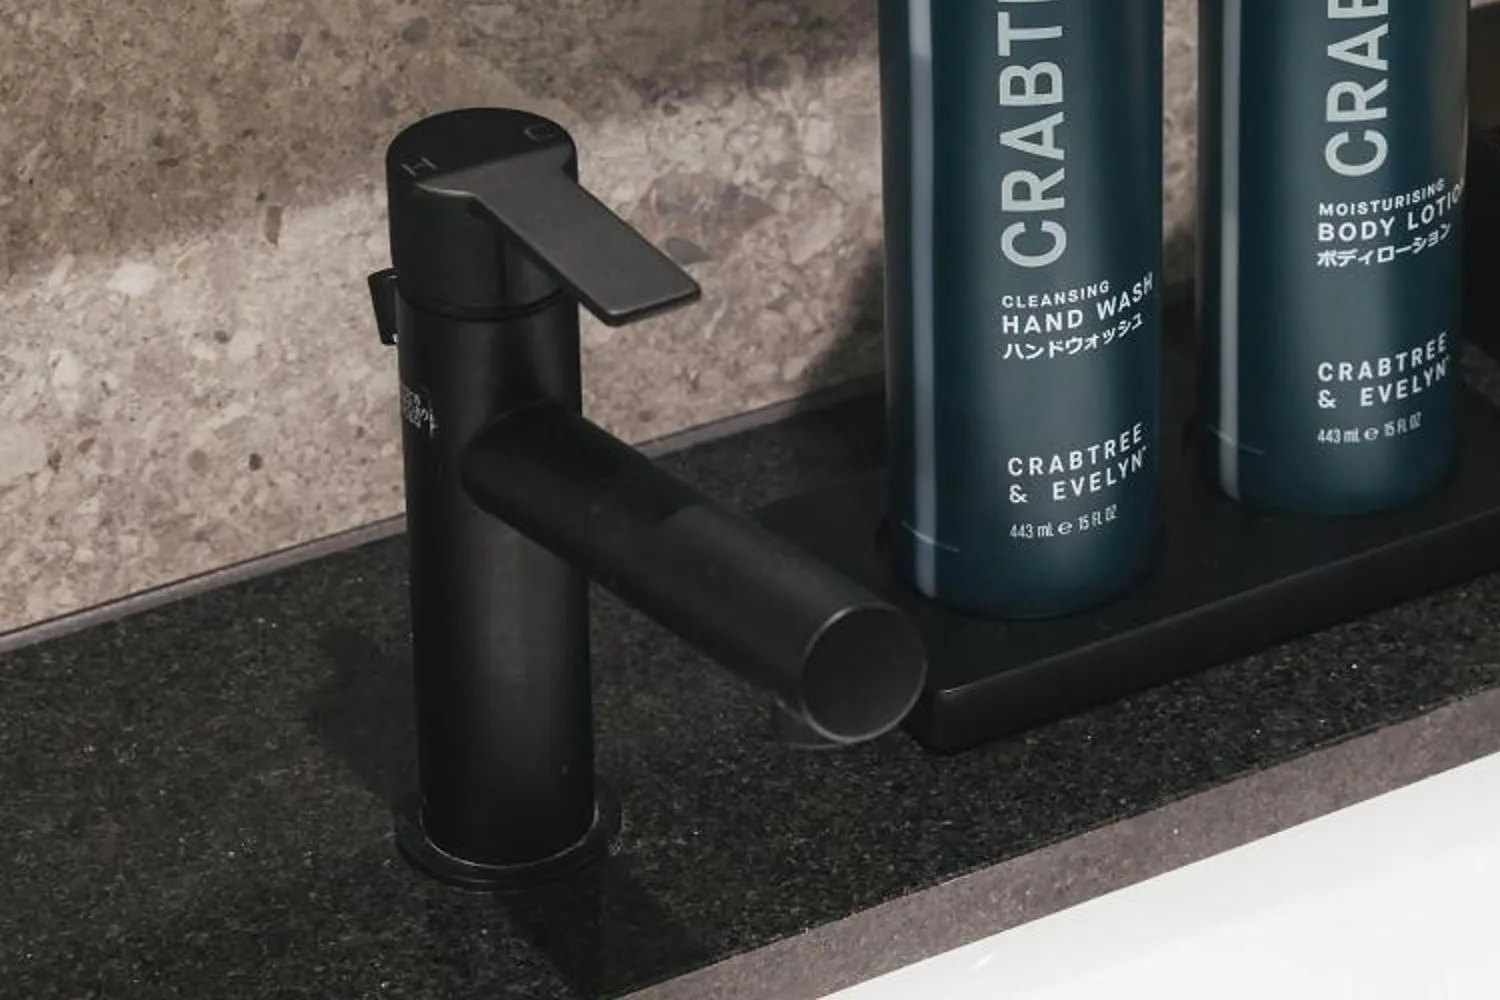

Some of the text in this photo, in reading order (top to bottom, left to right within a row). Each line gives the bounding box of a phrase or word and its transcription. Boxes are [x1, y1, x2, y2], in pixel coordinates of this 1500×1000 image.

[1318, 177, 1445, 217] MOISTURISING
[1316, 223, 1451, 268] ボディローション
[1317, 216, 1396, 243] BODY
[1001, 280, 1109, 309] CLEANSING
[1002, 271, 1153, 335] HAND WASH
[1002, 312, 1143, 360] ハンドウォッシュ
[1317, 332, 1447, 382] CRABTREE
[1317, 359, 1447, 409] & EVELYN
[1007, 421, 1142, 477] CRABTREE
[1317, 427, 1341, 444] 443
[1009, 448, 1143, 503] & EVELYN
[1009, 523, 1034, 539] 443
[1078, 513, 1090, 531] 15
